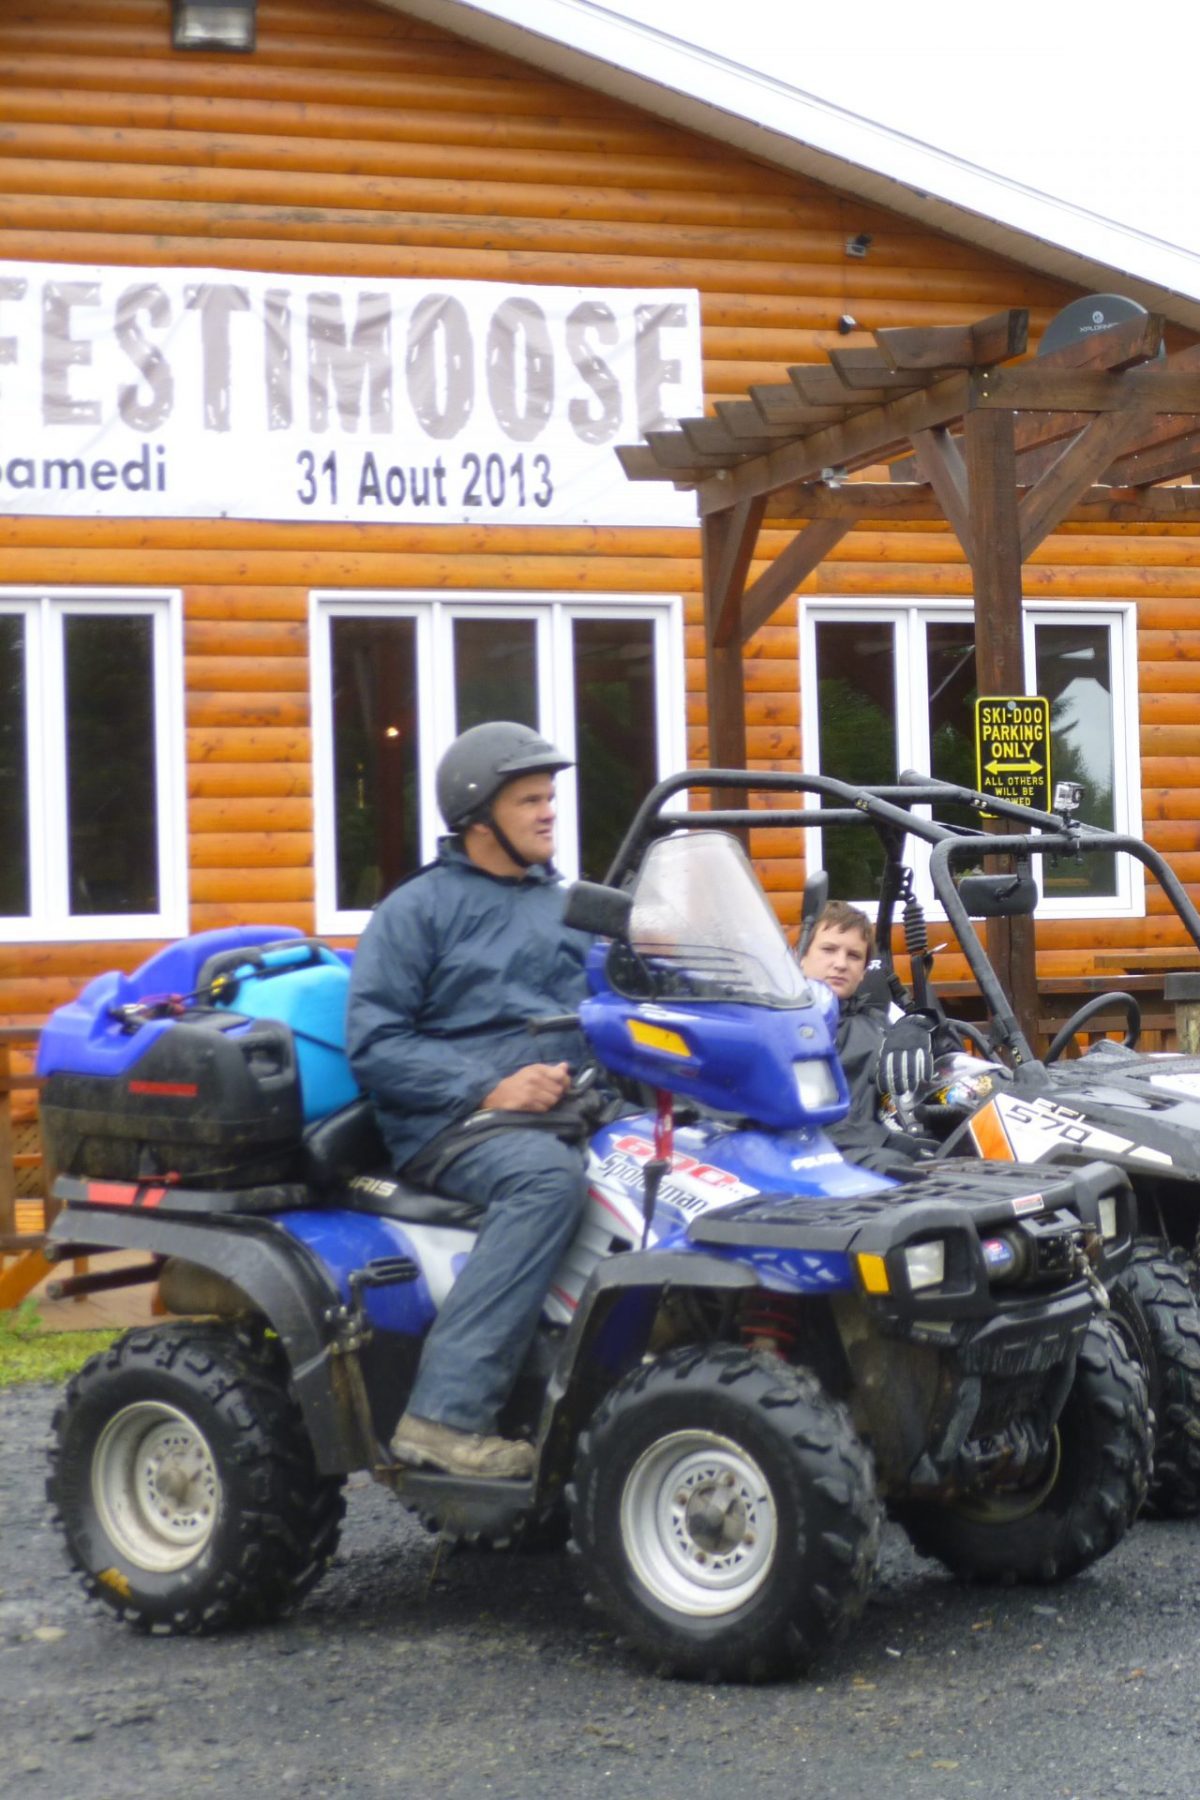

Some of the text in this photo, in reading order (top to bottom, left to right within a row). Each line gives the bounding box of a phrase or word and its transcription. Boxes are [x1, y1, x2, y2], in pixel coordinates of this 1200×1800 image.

[0, 443, 553, 508] amedi 31 Aout 2013
[982, 707, 1043, 724] SKI-DOO
[982, 725, 1043, 741] PARKING
[991, 742, 1035, 758] ONLY
[984, 776, 1044, 786] ALL OTHERS
[994, 787, 1035, 796] WILL BE
[1003, 797, 1031, 807] WED
[599, 1153, 709, 1213] Sporman
